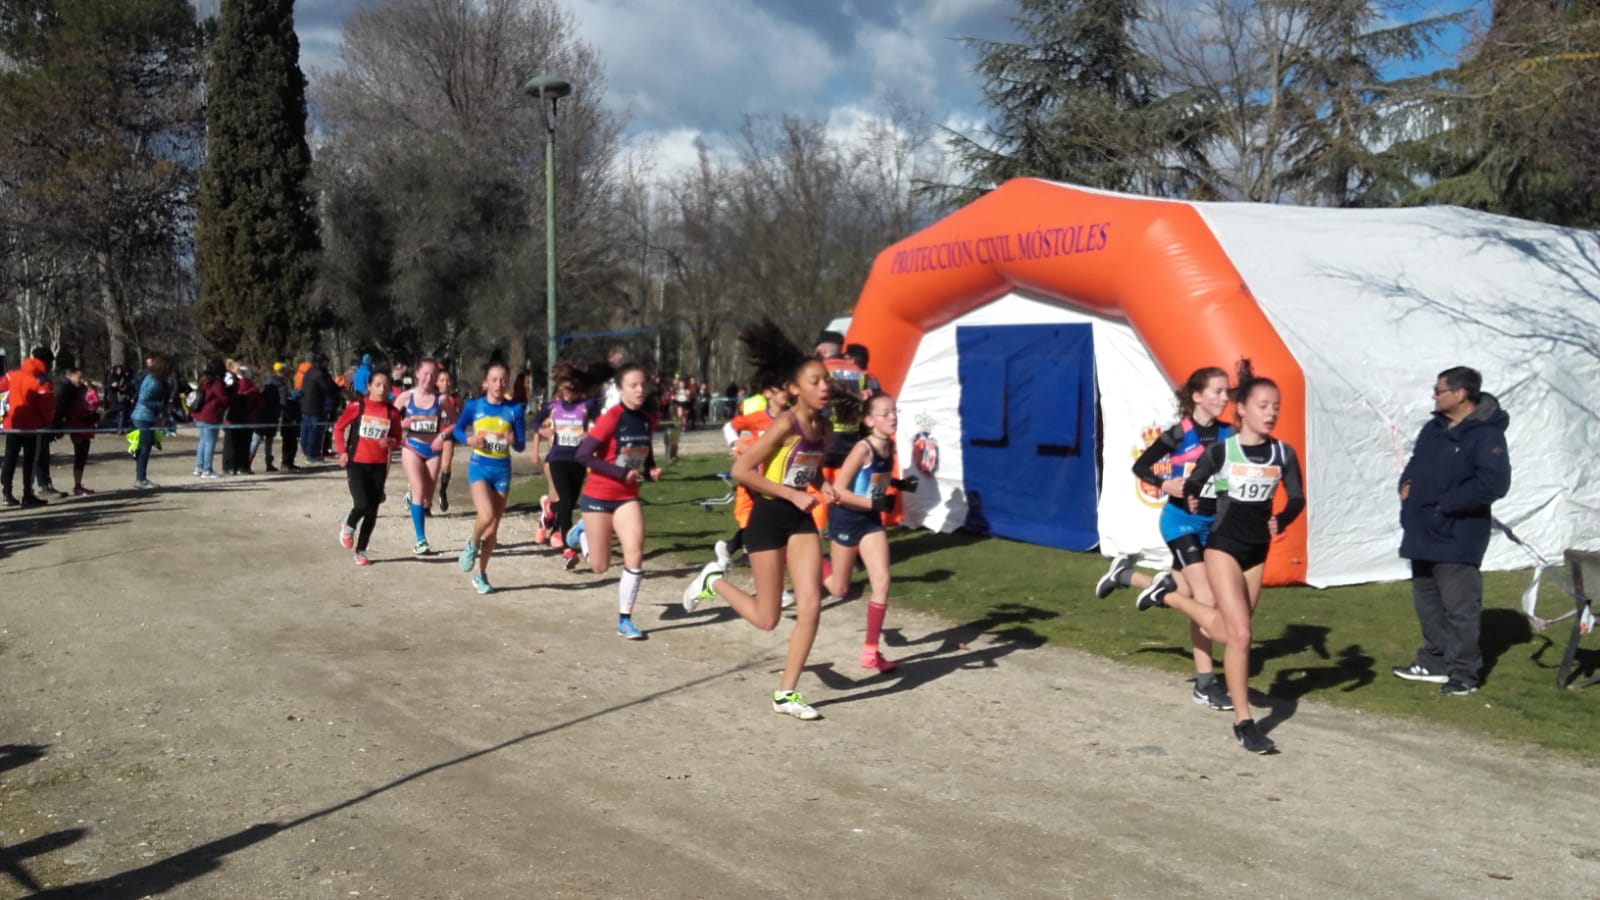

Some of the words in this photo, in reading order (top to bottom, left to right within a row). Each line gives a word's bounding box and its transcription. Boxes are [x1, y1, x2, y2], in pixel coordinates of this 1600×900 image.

[890, 235, 974, 274] PROTECCIÓN
[975, 234, 1016, 265] CIVIL
[1017, 222, 1111, 261] MÓSTOLES
[1238, 482, 1271, 499] 197
